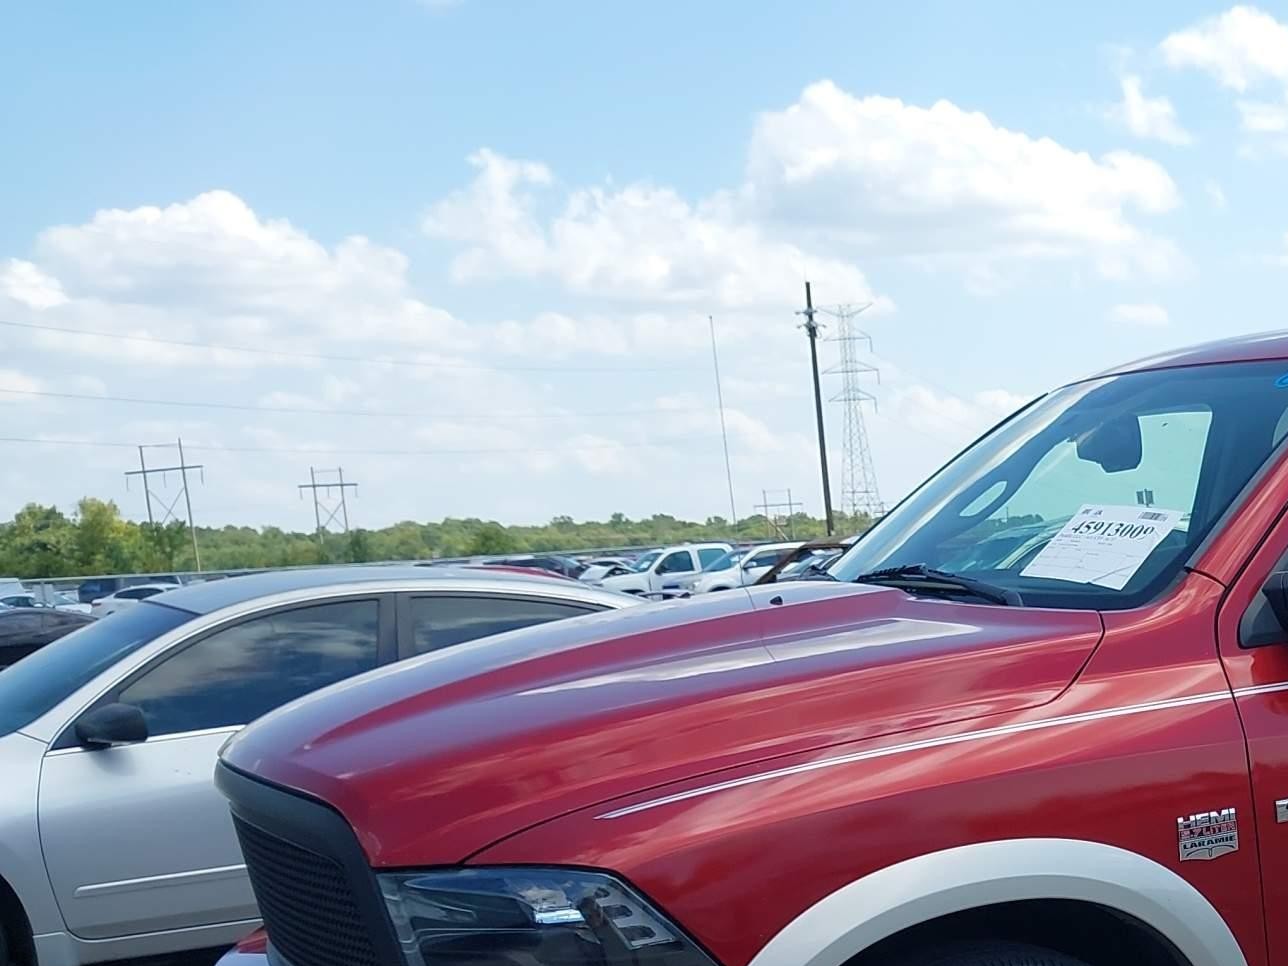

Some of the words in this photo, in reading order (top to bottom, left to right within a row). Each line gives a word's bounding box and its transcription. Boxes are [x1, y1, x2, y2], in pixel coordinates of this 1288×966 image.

[1072, 520, 1155, 540] 45913009
[1177, 807, 1236, 829] HEMI
[1183, 834, 1236, 850] LARAMIE
